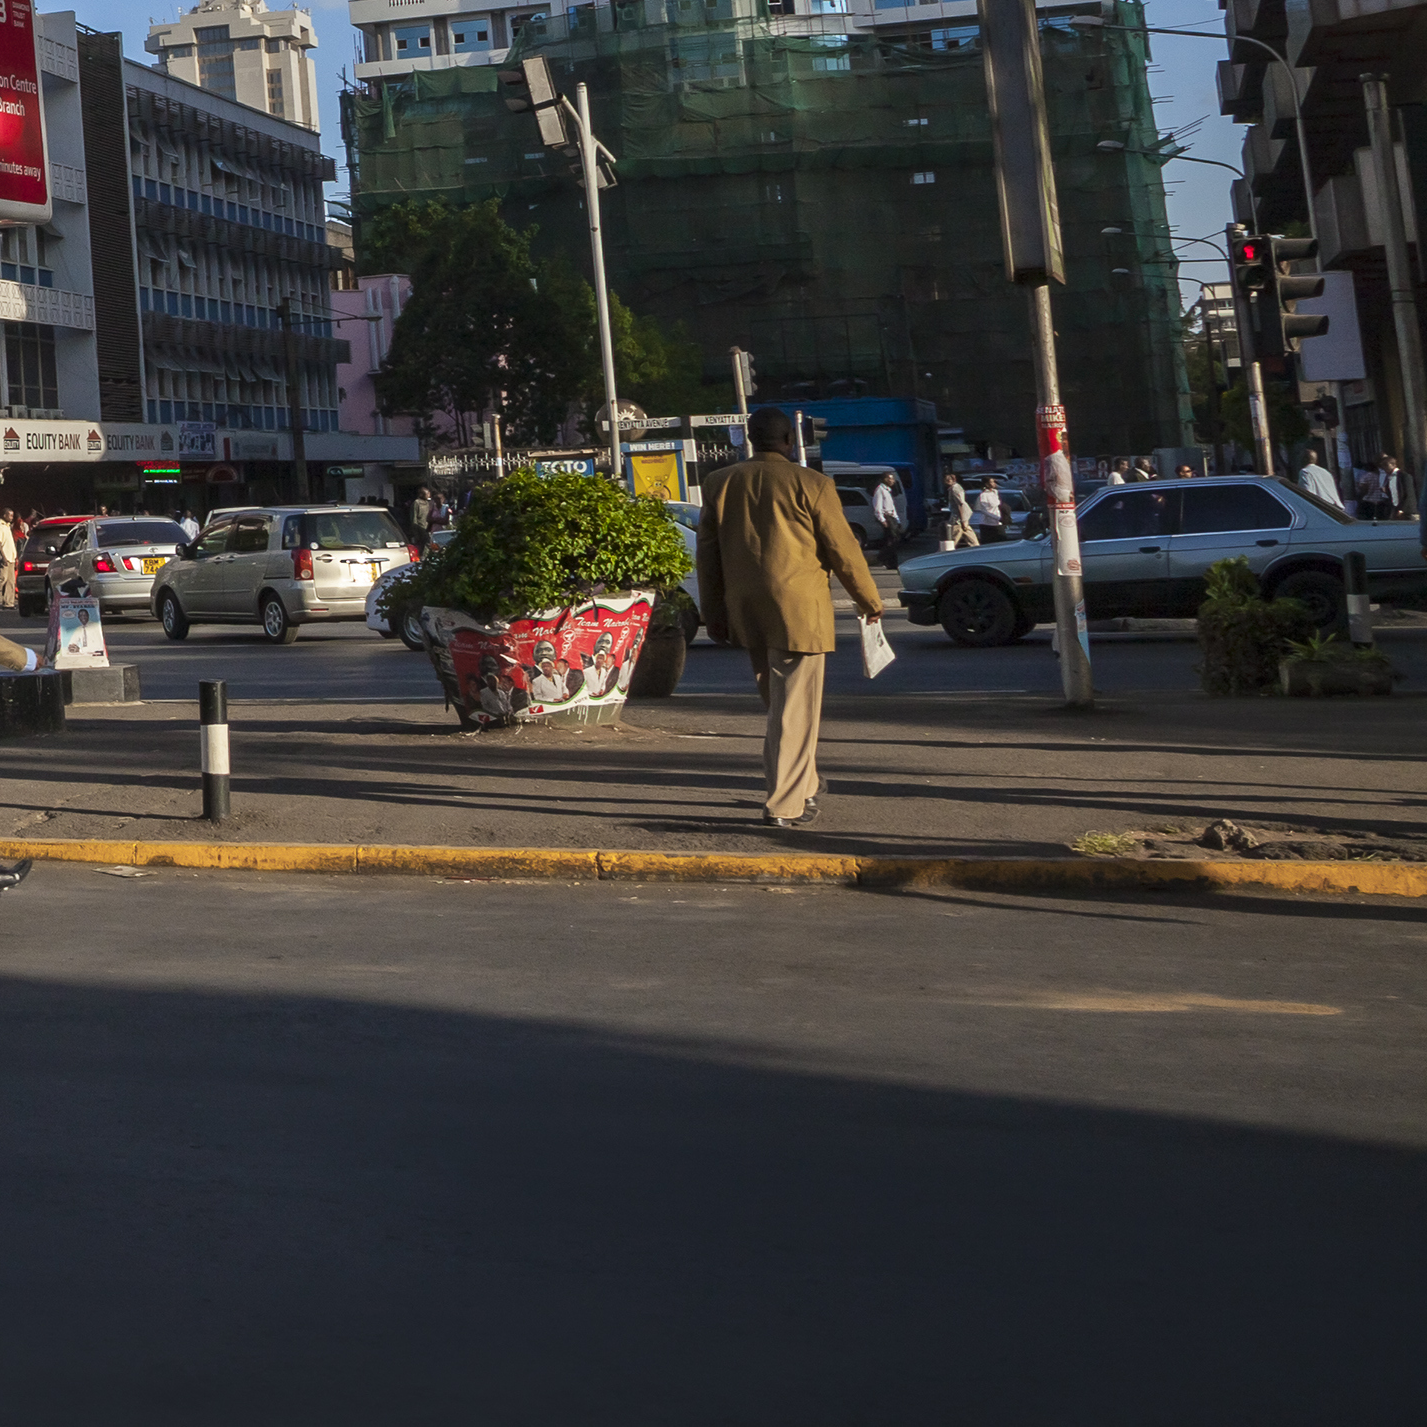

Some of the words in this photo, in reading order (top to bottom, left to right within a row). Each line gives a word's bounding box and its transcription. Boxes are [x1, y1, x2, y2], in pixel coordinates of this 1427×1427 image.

[12, 0, 30, 13] DIAMOND
[12, 10, 26, 20] TRUST
[13, 19, 25, 28] BANK
[10, 74, 37, 95] Centre
[23, 165, 41, 181] away
[646, 418, 669, 428] AVENUE
[705, 414, 735, 424] KENYATTA
[27, 432, 57, 450] EQUITY
[58, 433, 81, 450] BANK
[107, 434, 134, 450] EQUITY
[135, 435, 156, 450] BANK
[629, 443, 646, 451] WIN
[648, 442, 675, 450] HERE!
[575, 616, 600, 627] Team
[603, 617, 630, 628] Nairobi
